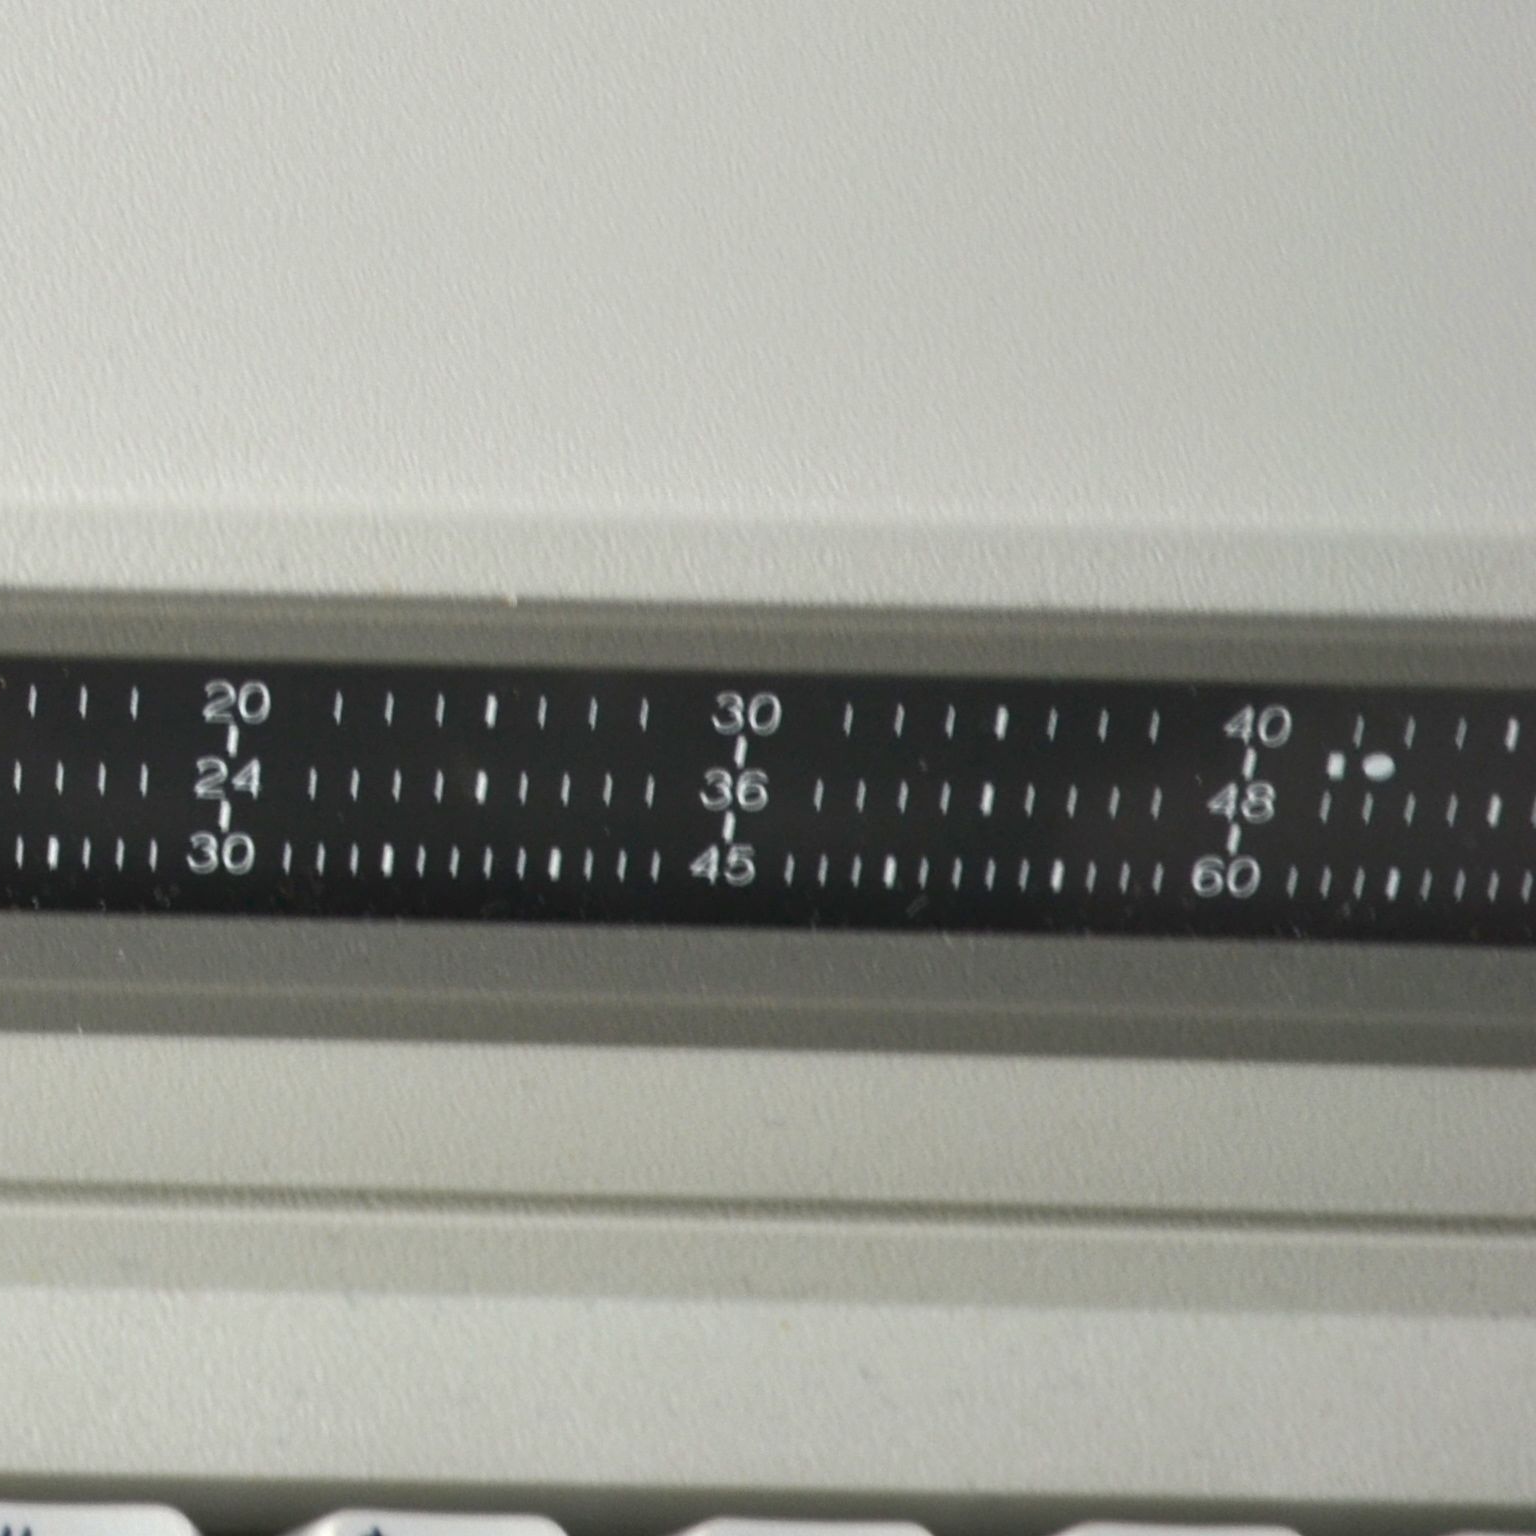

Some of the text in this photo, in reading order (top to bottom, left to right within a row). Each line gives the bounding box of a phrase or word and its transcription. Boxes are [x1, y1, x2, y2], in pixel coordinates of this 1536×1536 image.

[202, 679, 272, 725] 20
[710, 691, 783, 736] 30
[1223, 704, 1293, 749] 40
[194, 755, 262, 801] 24
[698, 768, 769, 813] 36
[1206, 780, 1277, 825] 48
[185, 831, 256, 876] 30
[688, 844, 757, 887] 45
[1190, 854, 1262, 899] 60
